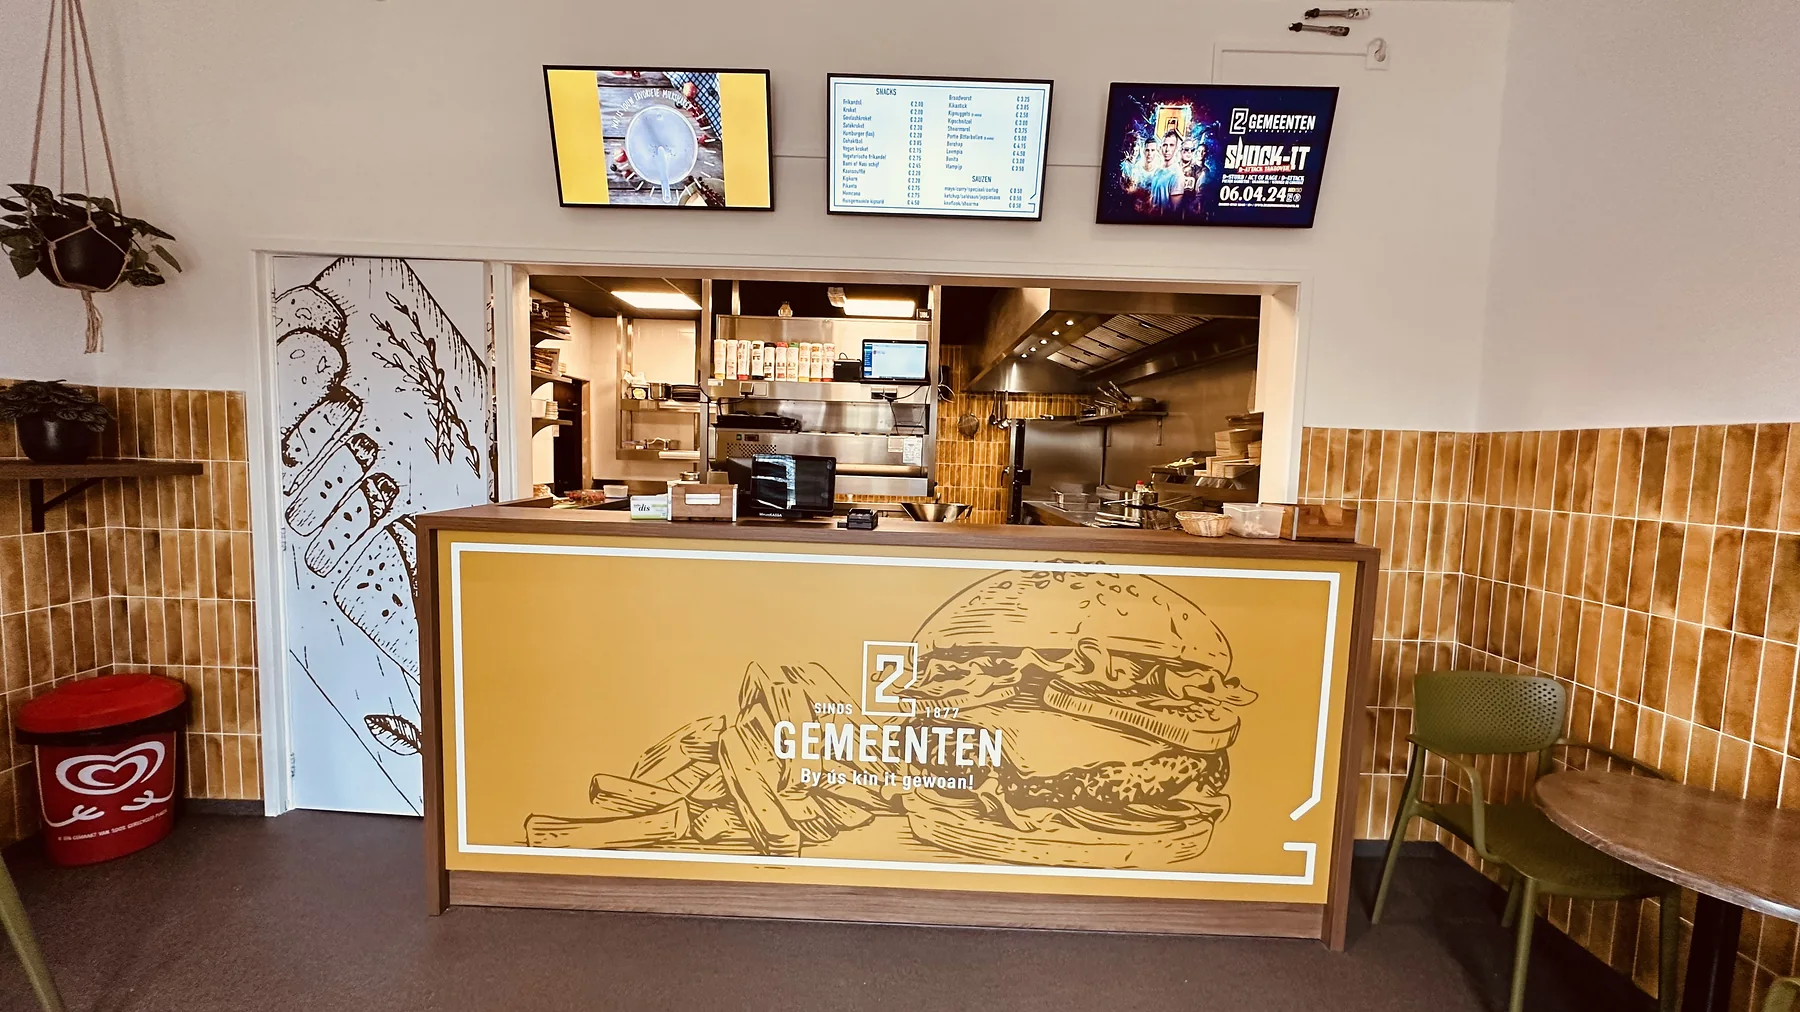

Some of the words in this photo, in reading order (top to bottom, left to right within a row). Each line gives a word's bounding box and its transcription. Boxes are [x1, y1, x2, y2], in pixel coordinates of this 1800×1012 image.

[1233, 112, 1245, 130] 2
[1248, 114, 1316, 130] GEMEENTEN
[1224, 136, 1310, 170] SHOCK-IT
[1220, 185, 1286, 202] 06.04.24
[875, 654, 904, 703] 2
[814, 702, 853, 715] SINDS
[925, 706, 960, 719] 1877
[773, 720, 1002, 767] GEMEENTEN
[801, 767, 821, 787] By
[826, 770, 846, 785] ús
[852, 770, 878, 786] kin
[884, 771, 896, 787] it
[902, 774, 975, 791] gewoan!
